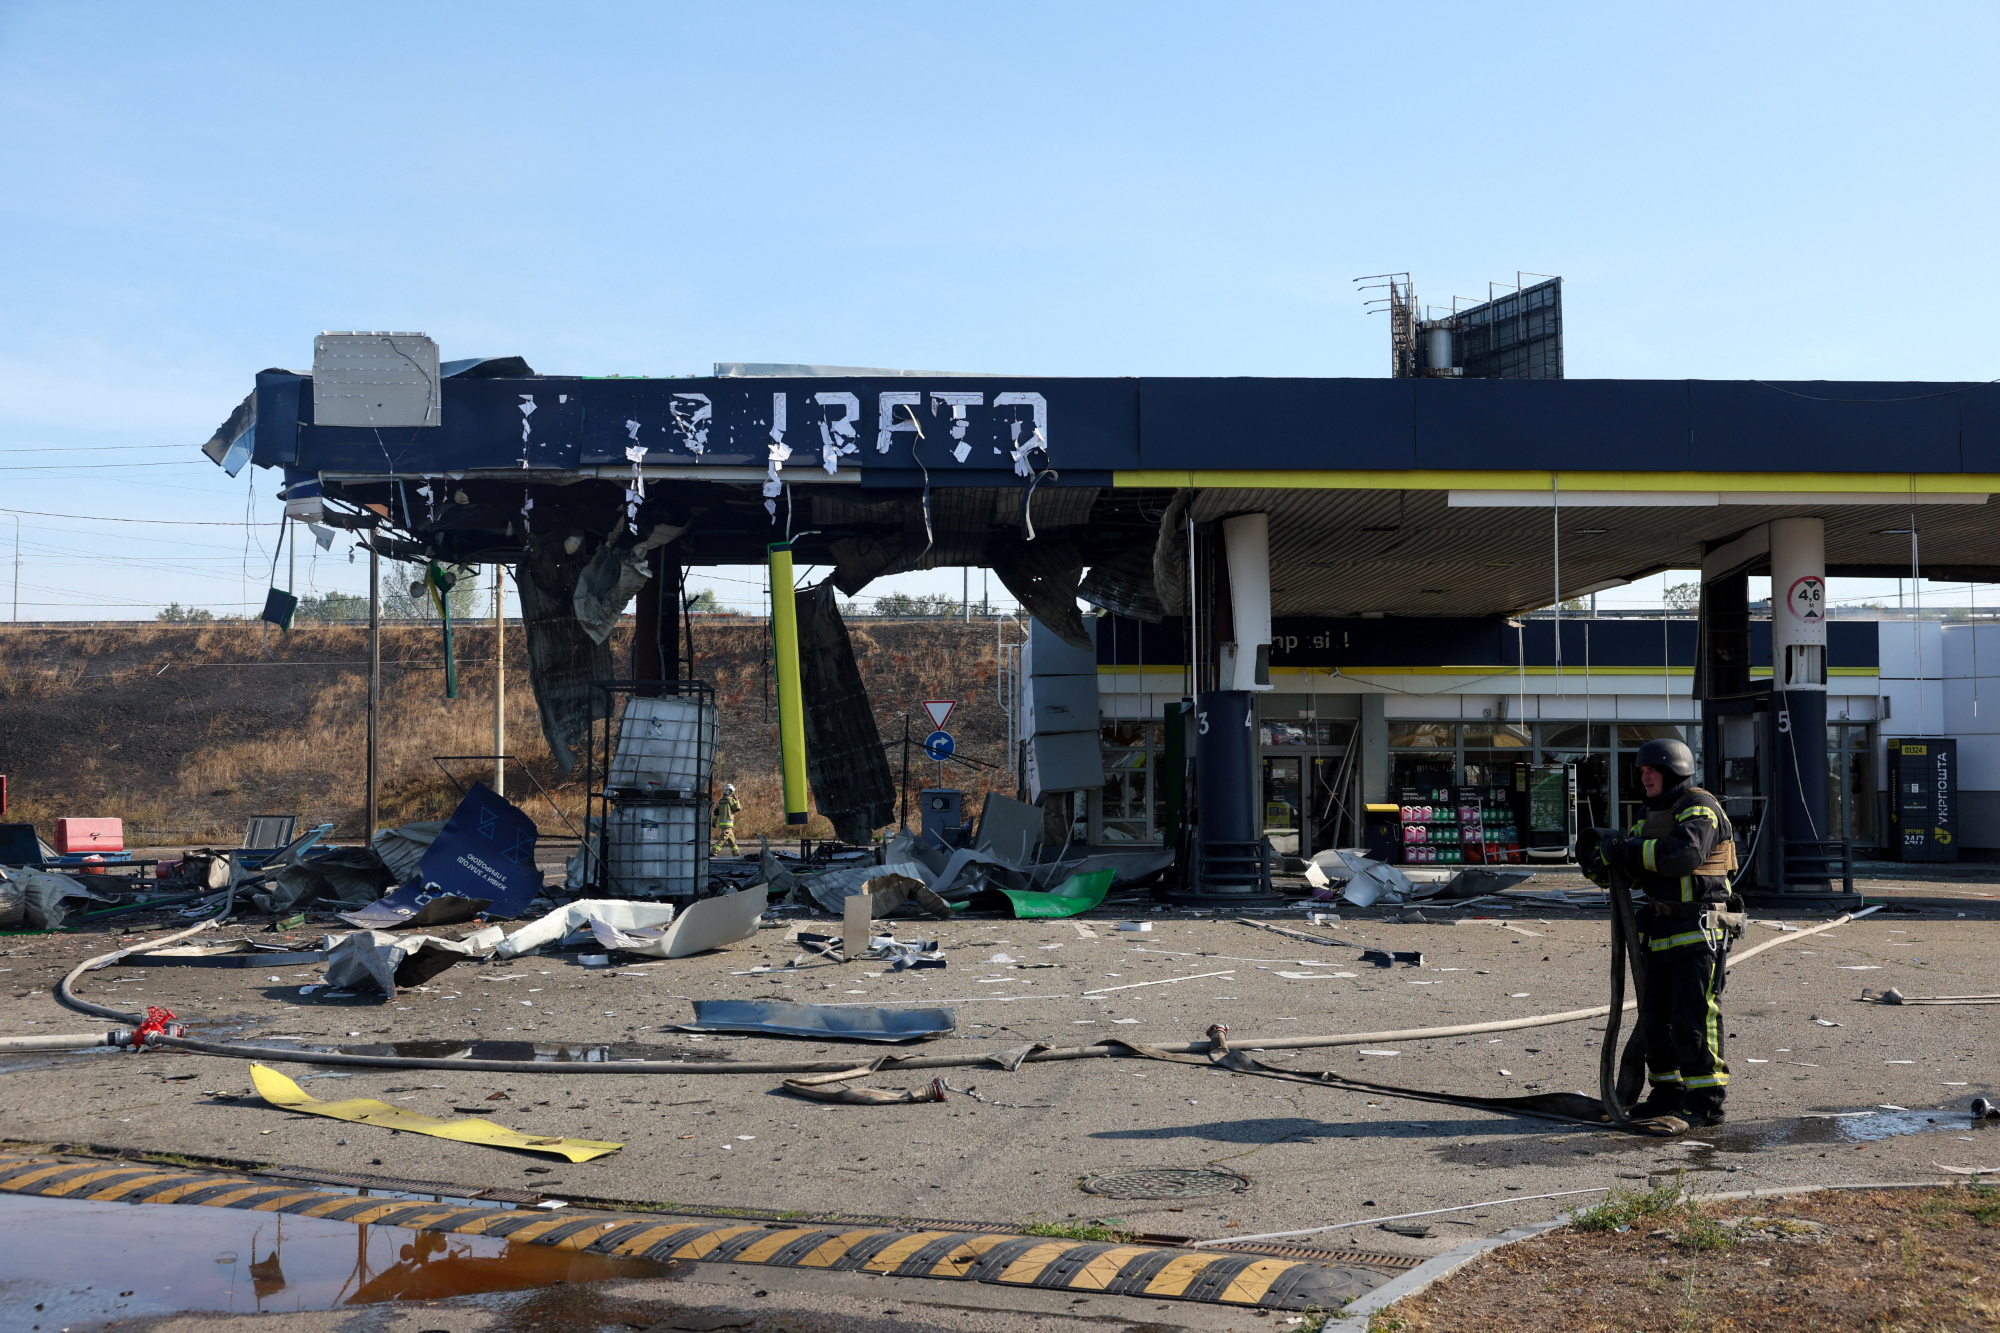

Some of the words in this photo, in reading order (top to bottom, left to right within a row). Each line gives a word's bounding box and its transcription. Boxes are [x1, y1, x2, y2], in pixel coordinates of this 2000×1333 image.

[1798, 589, 1820, 602] 4,6
[1198, 711, 1210, 735] 3
[1244, 709, 1252, 732] 4
[1778, 710, 1791, 733] 5
[1904, 746, 1923, 754] 01324
[1937, 751, 1948, 825] УКРПОШТА
[1904, 835, 1925, 845] 24/7
[456, 856, 484, 876] ЗЛАГОДІ
[467, 853, 503, 879] ПРИРОДОЮ
[486, 876, 508, 892] ЖИВИ
